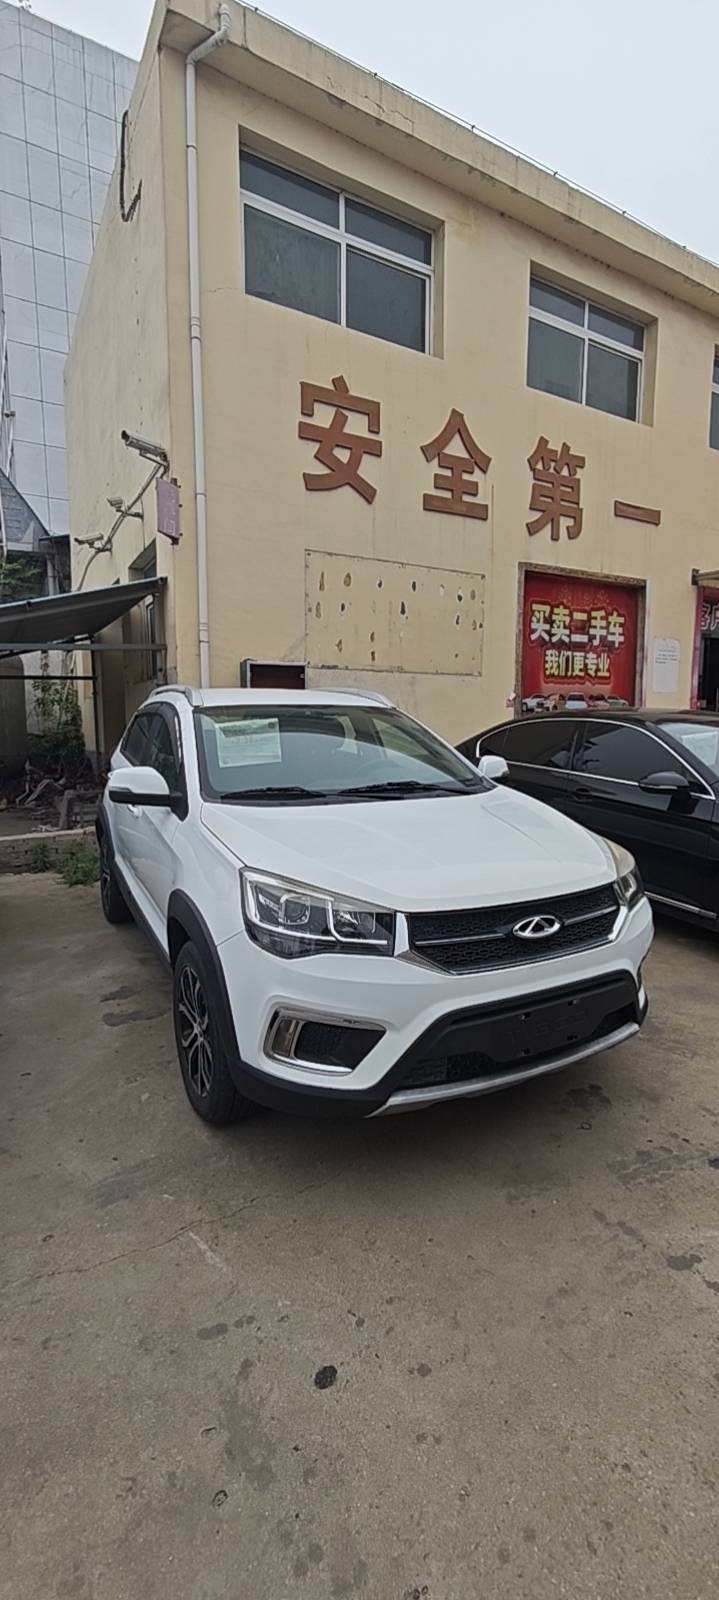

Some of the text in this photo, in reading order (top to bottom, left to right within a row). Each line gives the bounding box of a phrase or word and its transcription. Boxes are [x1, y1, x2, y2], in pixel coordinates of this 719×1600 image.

[298, 375, 661, 541] 安全第一
[530, 603, 625, 648] 买卖二手车
[545, 649, 610, 677] 我们更专业
